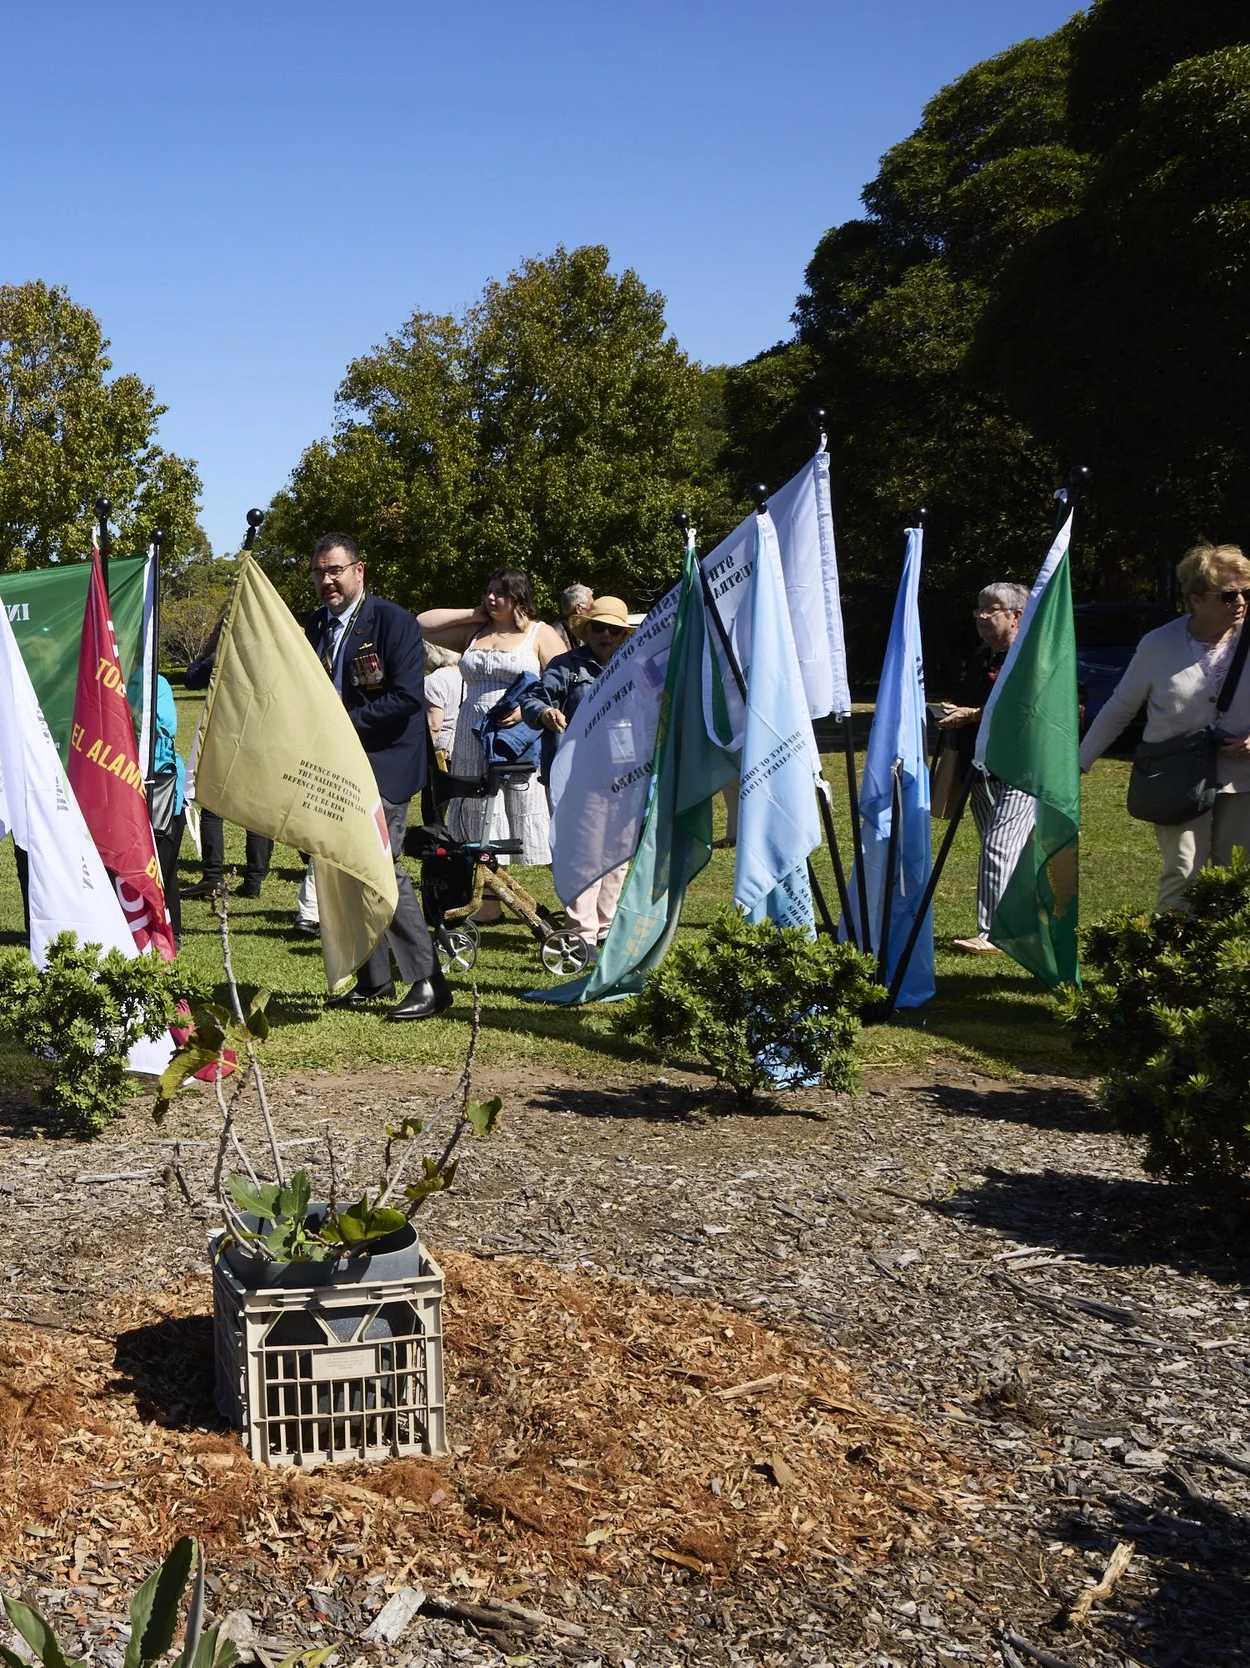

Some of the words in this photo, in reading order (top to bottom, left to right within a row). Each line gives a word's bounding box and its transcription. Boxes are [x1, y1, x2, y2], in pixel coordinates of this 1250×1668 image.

[71, 723, 83, 753] EL
[298, 769, 313, 780] THE
[313, 773, 342, 792] SALIENT
[300, 760, 331, 777] DEFENCE
[331, 772, 340, 781] OF
[282, 773, 316, 791] DEFENCE
[316, 786, 326, 796] OF
[326, 790, 354, 808] ALAMEIN
[302, 801, 312, 811] EL
[305, 792, 320, 804] TEL
[320, 797, 330, 808] EL
[329, 801, 346, 814] EISA
